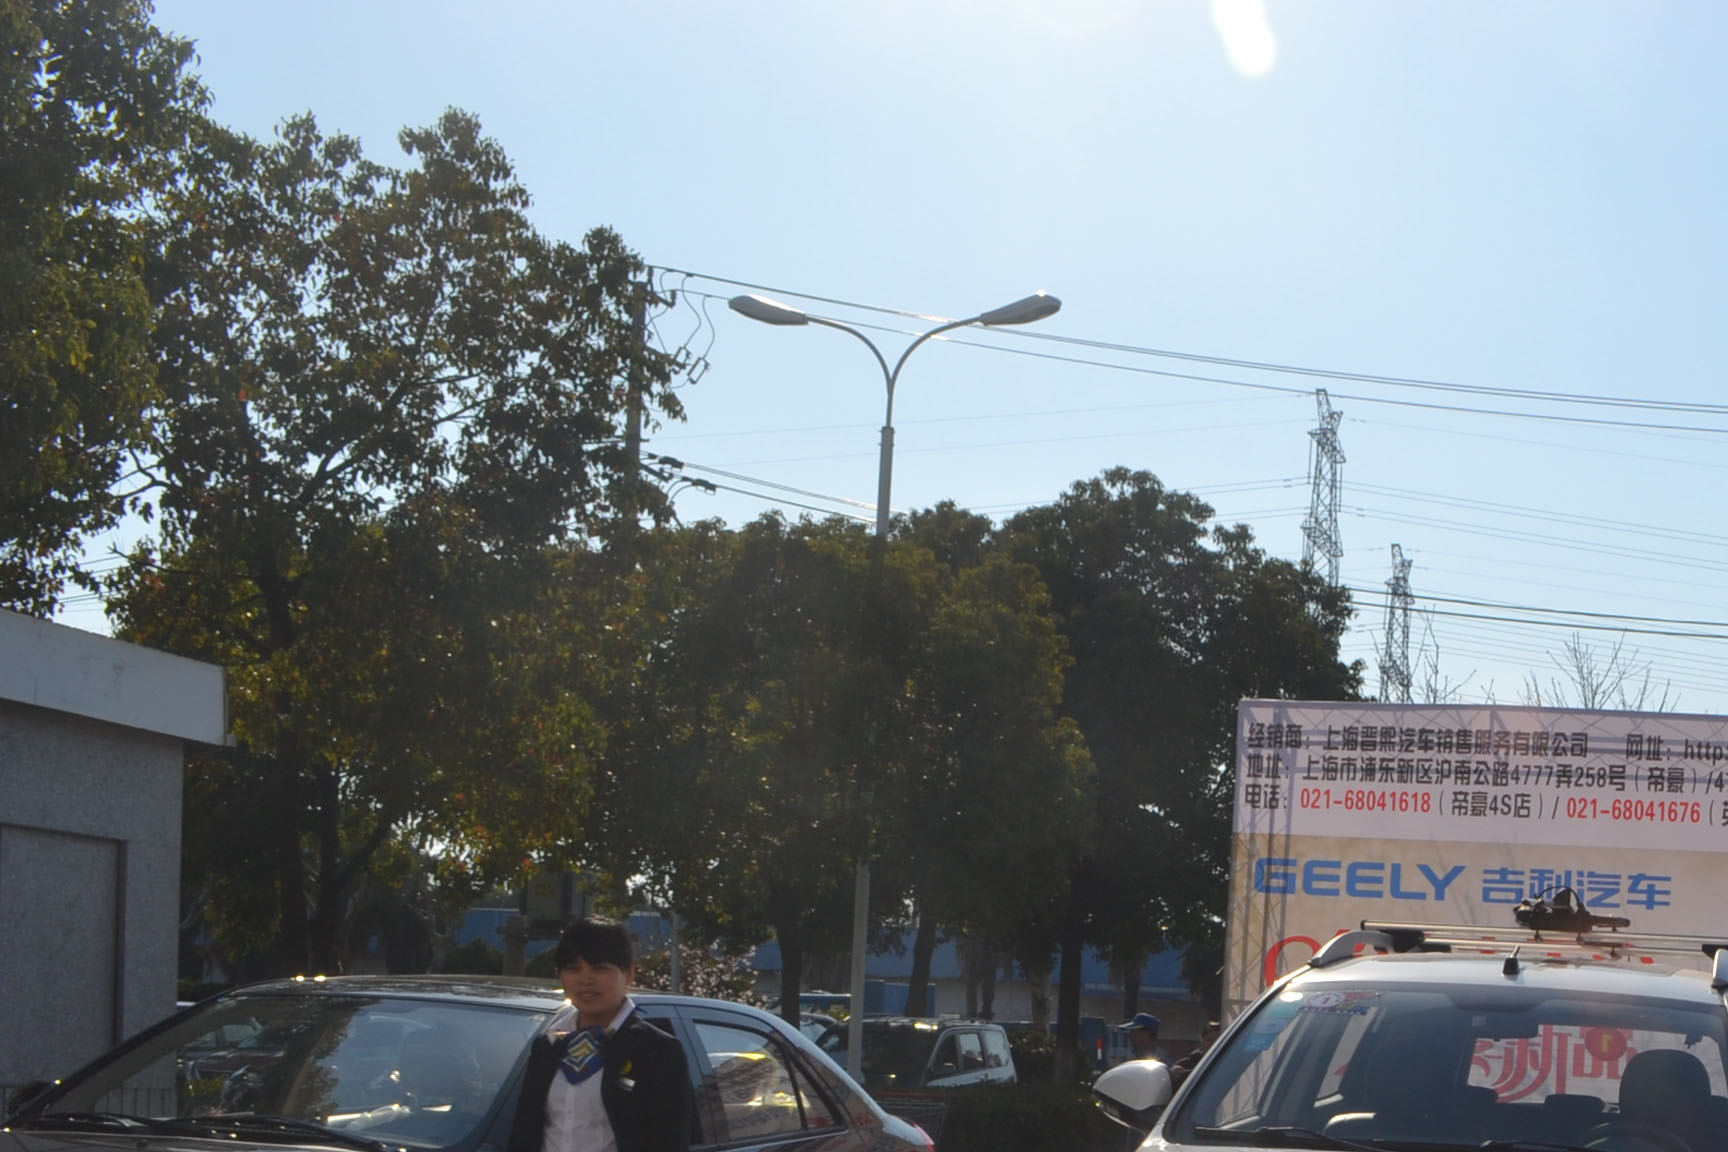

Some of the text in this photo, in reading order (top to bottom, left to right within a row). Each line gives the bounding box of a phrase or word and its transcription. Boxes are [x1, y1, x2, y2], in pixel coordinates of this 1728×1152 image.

[1254, 857, 1672, 910] GEELY 吉利汽车
